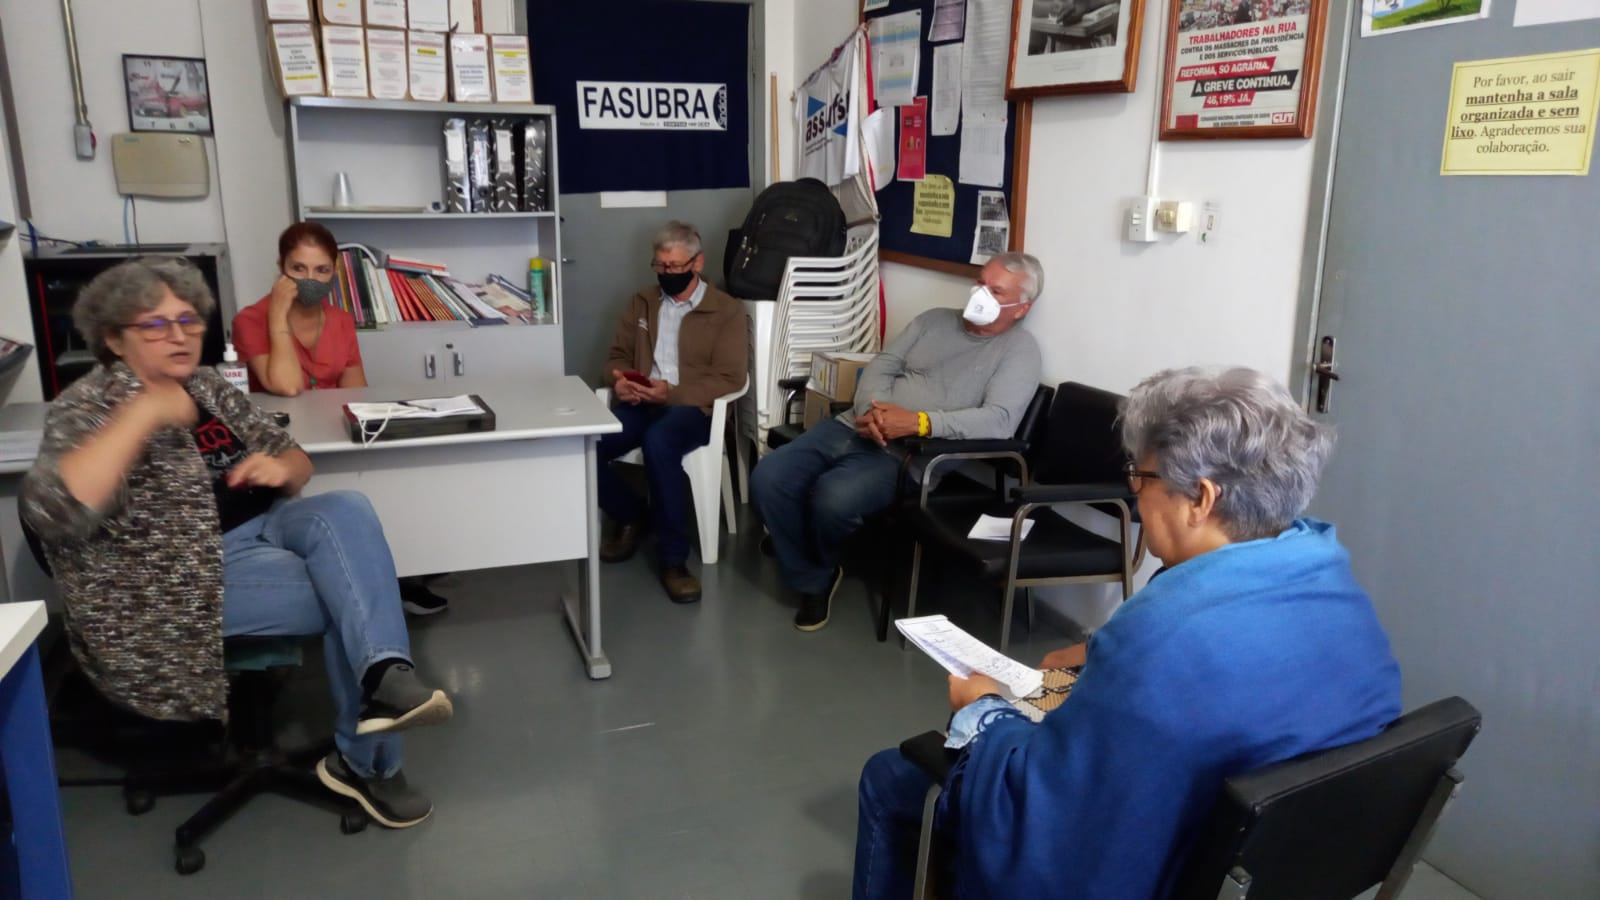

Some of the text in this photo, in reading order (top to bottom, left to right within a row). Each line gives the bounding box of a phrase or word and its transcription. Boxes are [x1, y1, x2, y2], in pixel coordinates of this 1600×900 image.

[1189, 21, 1297, 45] TRABALHADORES NA RUA
[1181, 46, 1203, 55] CONTRA
[1214, 39, 1249, 51] MASSACRES
[1250, 37, 1260, 45] DA
[1261, 32, 1304, 45] PREVIDÊNCIA
[1204, 52, 1216, 60] DOS
[1217, 49, 1246, 59] SERVIÇOS
[1194, 75, 1290, 93] A GREVE CONTINUA.
[1473, 68, 1576, 88] Por favor, ao sair
[583, 86, 709, 119] FASUBRA
[1206, 93, 1236, 106] 46,19%
[1466, 85, 1578, 105] mantenha a sala
[1460, 105, 1580, 123] organizada e sem
[1451, 123, 1586, 139] lixo. Agradecemos sua
[1476, 140, 1550, 155] colaboração.
[223, 370, 243, 378] USE
